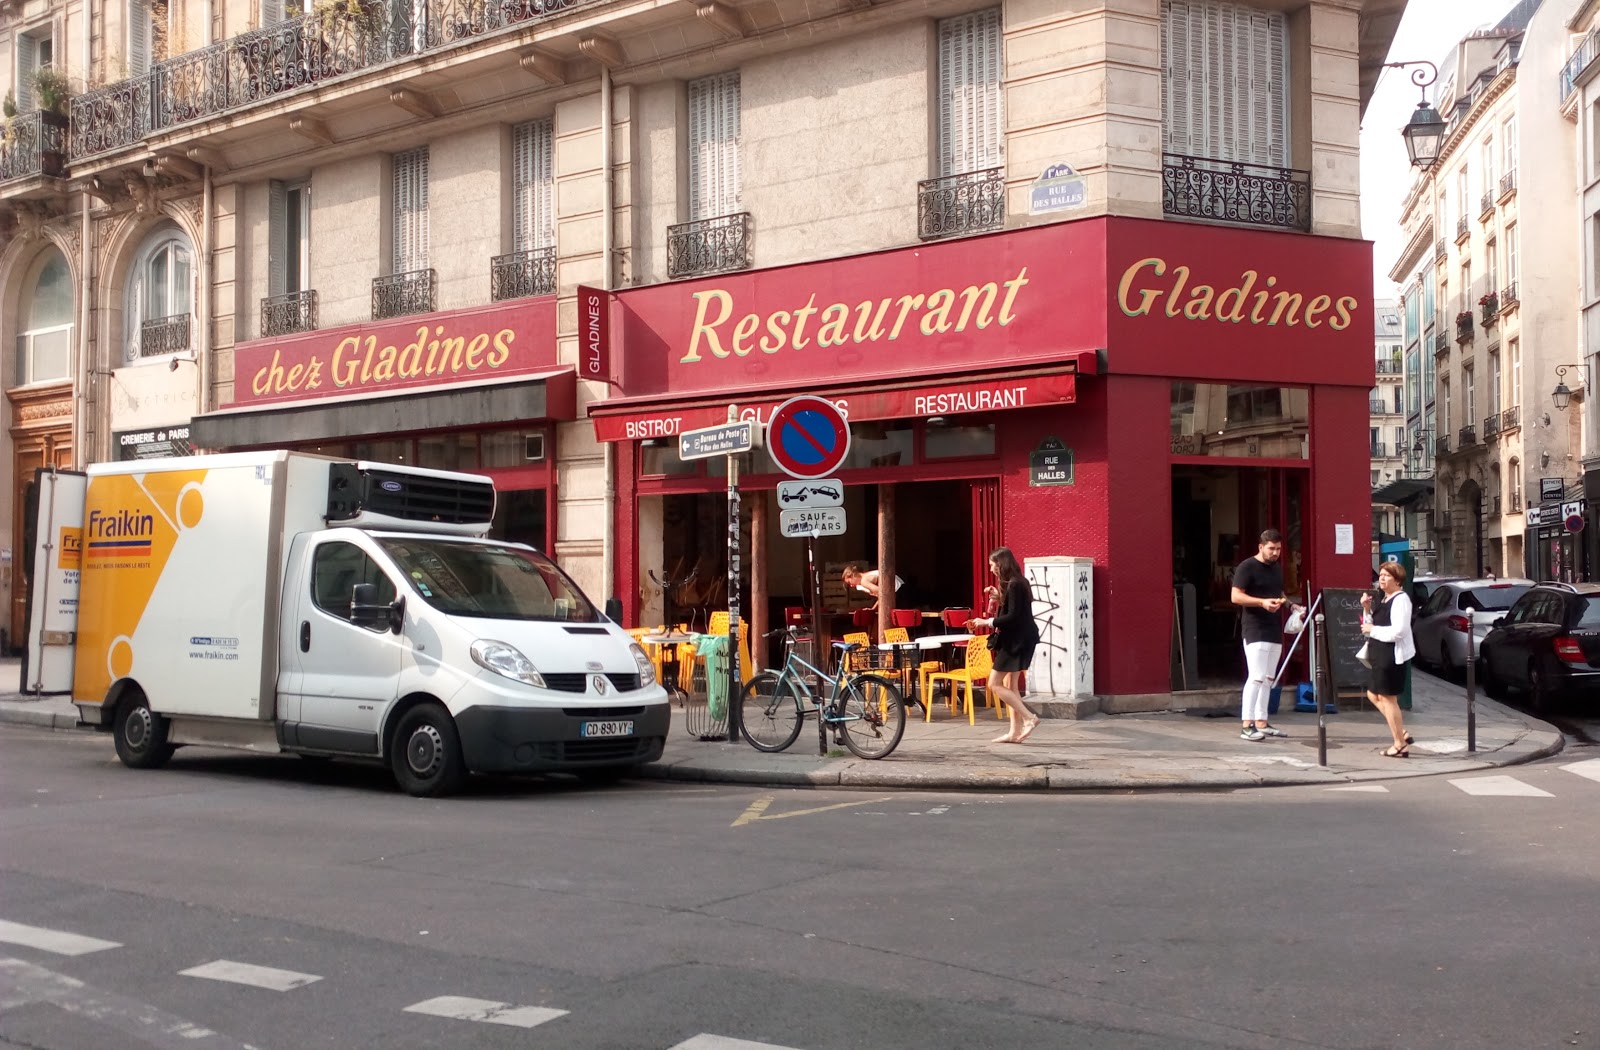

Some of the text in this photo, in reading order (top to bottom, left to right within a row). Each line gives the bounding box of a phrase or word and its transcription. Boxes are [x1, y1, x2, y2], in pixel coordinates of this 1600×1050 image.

[1048, 185, 1067, 196] RUE
[1033, 194, 1082, 208] DES HALLES
[1118, 257, 1358, 331] Gladines
[679, 266, 1030, 364] Restaurant
[588, 295, 601, 374] GLADINES
[252, 325, 515, 396] chez Gladines
[914, 387, 1028, 415] RESTAURANT
[625, 417, 682, 438] BISTROT
[121, 428, 189, 445] CREMERIE de PARIS
[700, 430, 740, 443] Bureau de Poste
[1044, 456, 1059, 465] RUE
[1037, 471, 1066, 480] HALLES
[88, 509, 153, 538] Fraikin
[800, 512, 827, 522] SAUF
[189, 651, 239, 660] www.fraikin.com
